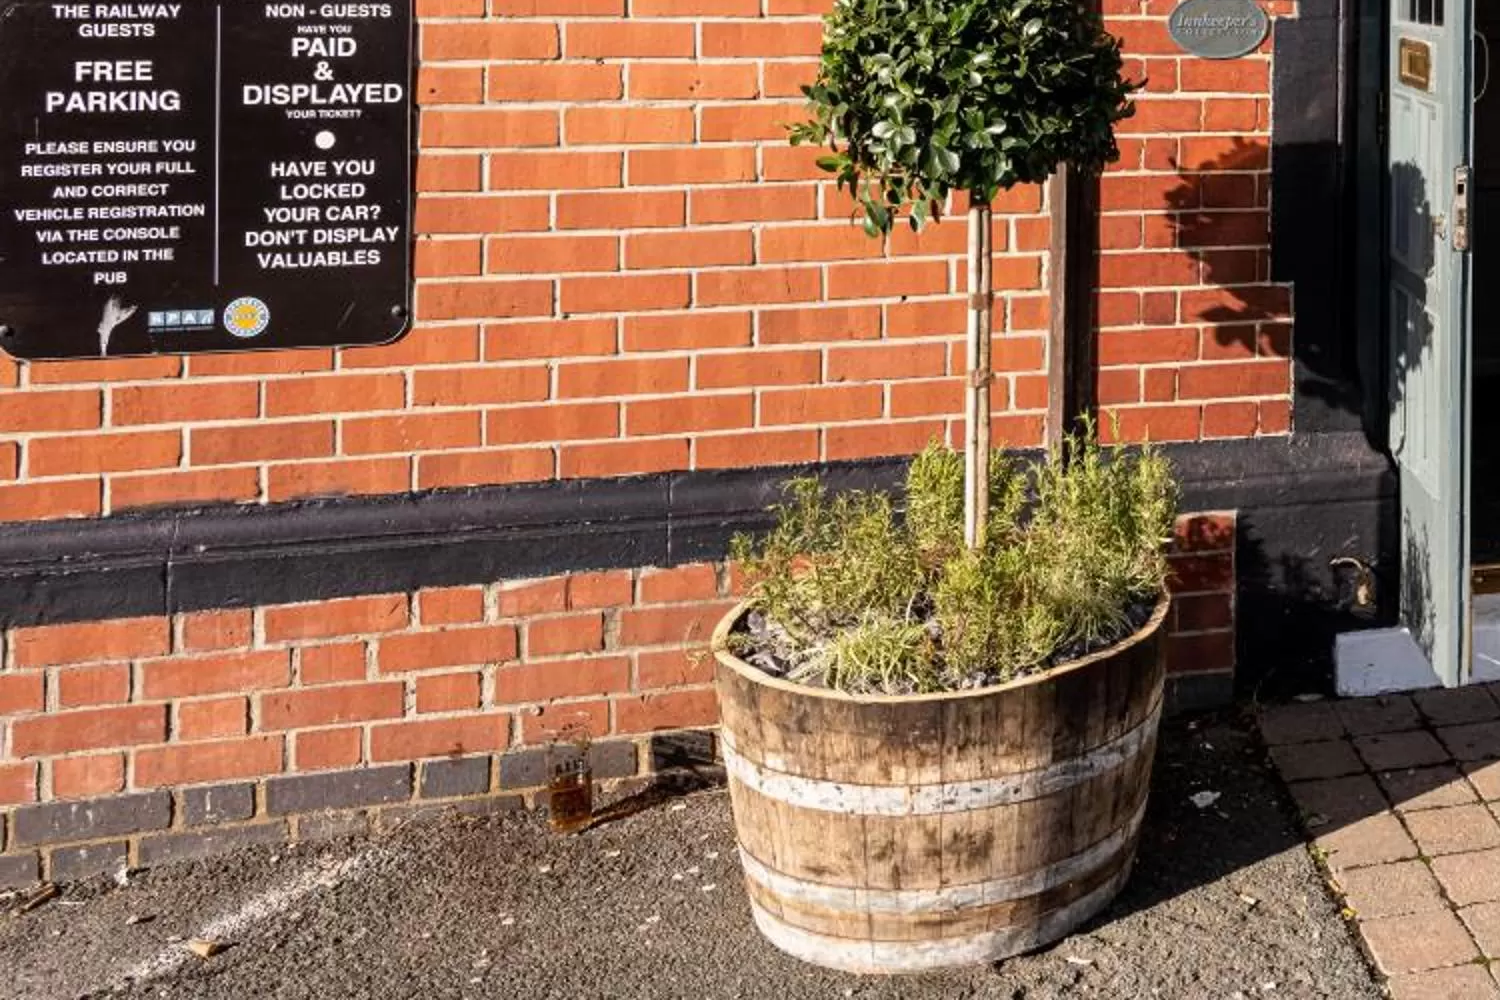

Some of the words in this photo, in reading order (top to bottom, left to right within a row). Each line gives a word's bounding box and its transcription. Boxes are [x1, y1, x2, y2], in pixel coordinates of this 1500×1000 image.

[52, 4, 91, 18] THE
[95, 4, 182, 18] RAILWAY
[265, 4, 304, 18] NON
[320, 3, 392, 18] GUESTS
[78, 23, 156, 38] GUESTS
[297, 25, 327, 34] HAVE
[329, 25, 353, 34] YOU
[291, 36, 358, 57] PAID
[75, 60, 153, 82] FREE
[313, 61, 335, 81] &
[45, 90, 181, 113] PARKING
[242, 83, 404, 105] DISPLAYED
[285, 109, 317, 119] YOUR
[25, 141, 89, 155] PLEASE
[93, 140, 159, 154] ENSURE
[162, 139, 197, 153] YOU
[21, 163, 103, 177] REGISTER
[106, 162, 151, 175] YOUR
[155, 161, 196, 174] FULL
[271, 160, 327, 178] HAVE
[331, 159, 376, 176] YOU
[52, 185, 88, 199] AND
[91, 183, 170, 198] CORRECT
[280, 183, 367, 201] LOCKED
[14, 207, 84, 221] VEHICLE
[87, 204, 206, 220] REGISTRATION
[263, 206, 321, 223] YOUR
[325, 204, 382, 222] CAR?
[36, 230, 63, 243] VIA
[66, 229, 99, 242] THE
[102, 226, 181, 241] CONSOLE
[245, 229, 309, 247] DON'T
[312, 226, 400, 245] DISPLAY
[41, 250, 119, 265] LOCATED
[122, 249, 139, 262] IN
[142, 248, 175, 261] THE
[257, 249, 382, 269] VALUABLES
[93, 271, 128, 285] PUB
